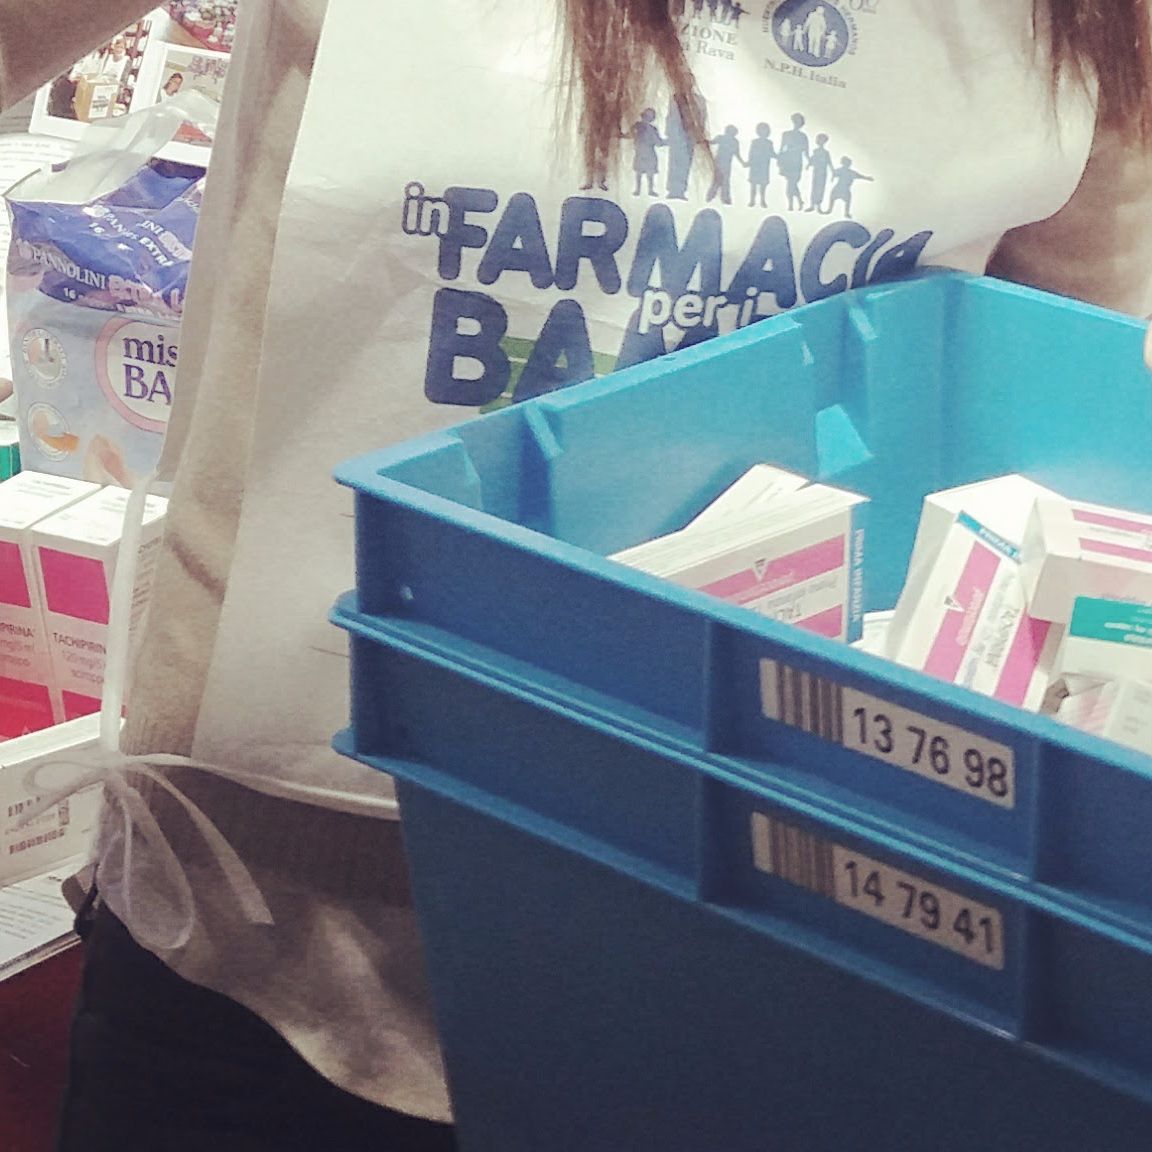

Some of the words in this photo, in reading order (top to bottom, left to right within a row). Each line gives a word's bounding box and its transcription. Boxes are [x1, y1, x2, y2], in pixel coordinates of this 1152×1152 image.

[696, 40, 736, 61] Rava
[809, 71, 848, 89] Italia
[403, 182, 449, 236] in
[33, 247, 106, 289] PANNOLINI
[637, 288, 729, 335] per
[52, 632, 107, 655] TACHIPIRIN
[853, 707, 894, 754] 13
[906, 726, 950, 775] 76
[963, 748, 1008, 798] 98
[845, 860, 885, 906] 14
[897, 881, 941, 931] 79
[953, 908, 993, 954] 41
